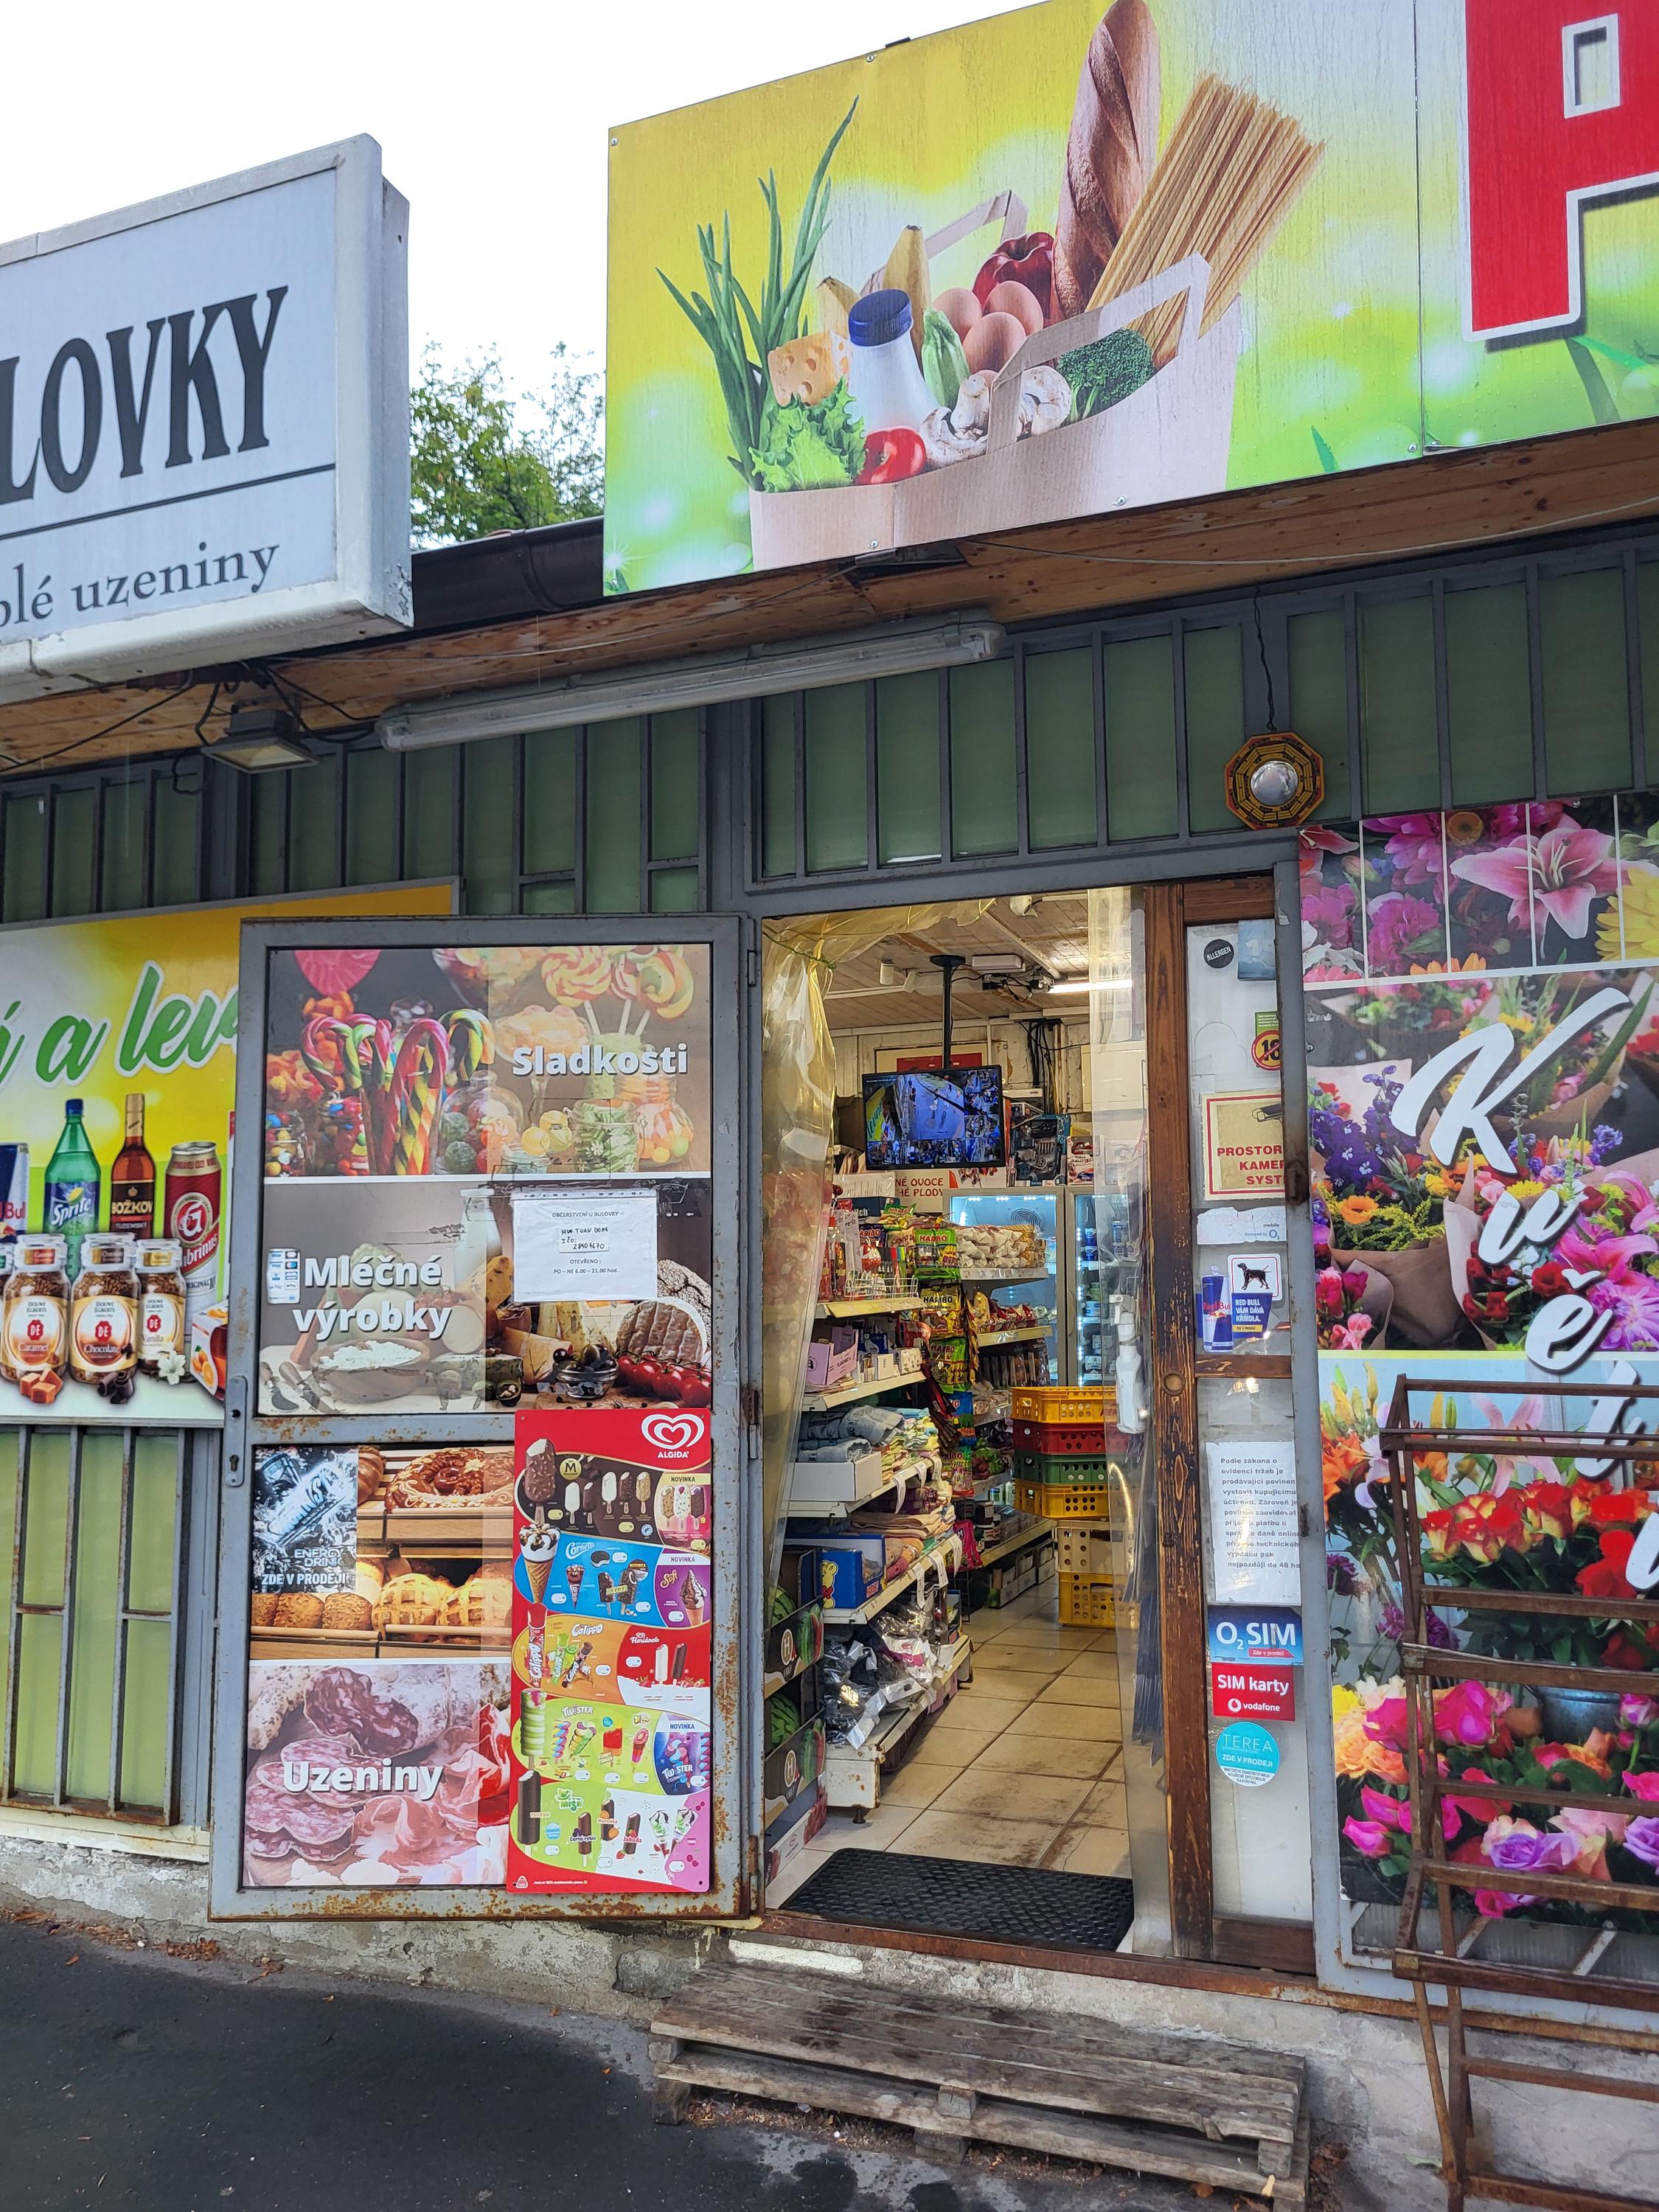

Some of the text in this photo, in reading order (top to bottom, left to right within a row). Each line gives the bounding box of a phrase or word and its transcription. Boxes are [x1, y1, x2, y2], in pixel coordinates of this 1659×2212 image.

[0, 285, 288, 504] LOVKY
[72, 541, 280, 594] uzeniny
[1206, 946, 1231, 961] ALLERGEN
[36, 1015, 108, 1082] a
[1262, 1039, 1280, 1061] 18
[512, 1043, 688, 1077] Sladkosti
[911, 1178, 944, 1186] OVOCE
[1246, 1175, 1284, 1185] SYST
[859, 1229, 881, 1238] ARIBO
[919, 1234, 947, 1242] HARBO
[305, 1254, 442, 1288] Mléčné
[923, 1295, 953, 1304] HARIBO
[292, 1301, 453, 1341] výrobky
[262, 1573, 347, 1585] ZDE V PRODEJI
[1246, 1622, 1296, 1646] SIM
[1217, 1674, 1289, 1696] SIM karty
[1242, 1703, 1281, 1711] vodafone
[1223, 1734, 1273, 1753] TEREA
[1222, 1753, 1236, 1762] ZDE
[1243, 1756, 1273, 1767] PRODEJI
[284, 1758, 444, 1801] Uzeniny
